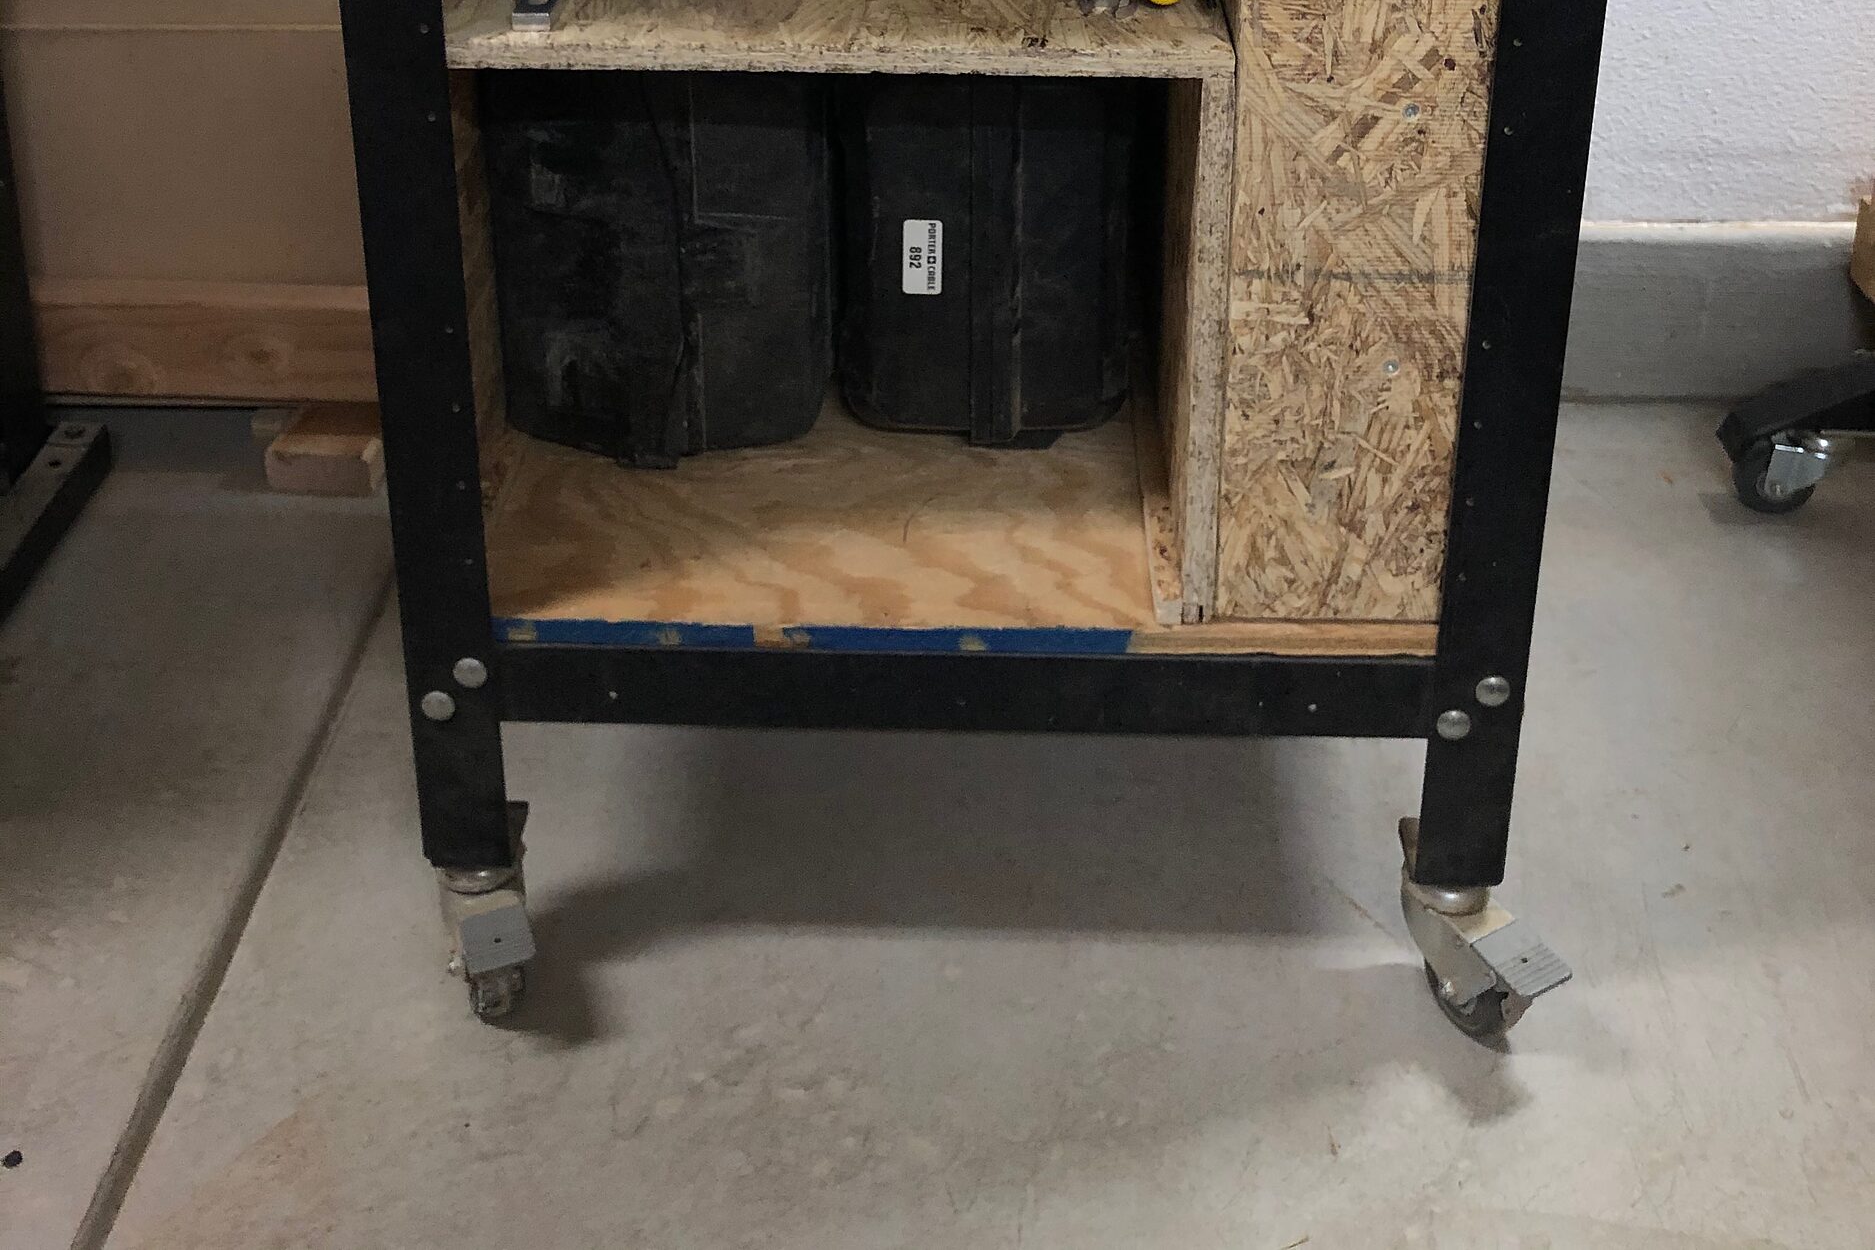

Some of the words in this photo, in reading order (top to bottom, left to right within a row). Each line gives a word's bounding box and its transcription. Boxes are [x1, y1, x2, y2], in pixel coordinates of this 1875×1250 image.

[927, 222, 937, 255] PORTER
[909, 246, 922, 269] 892
[926, 266, 936, 291] CABLE
